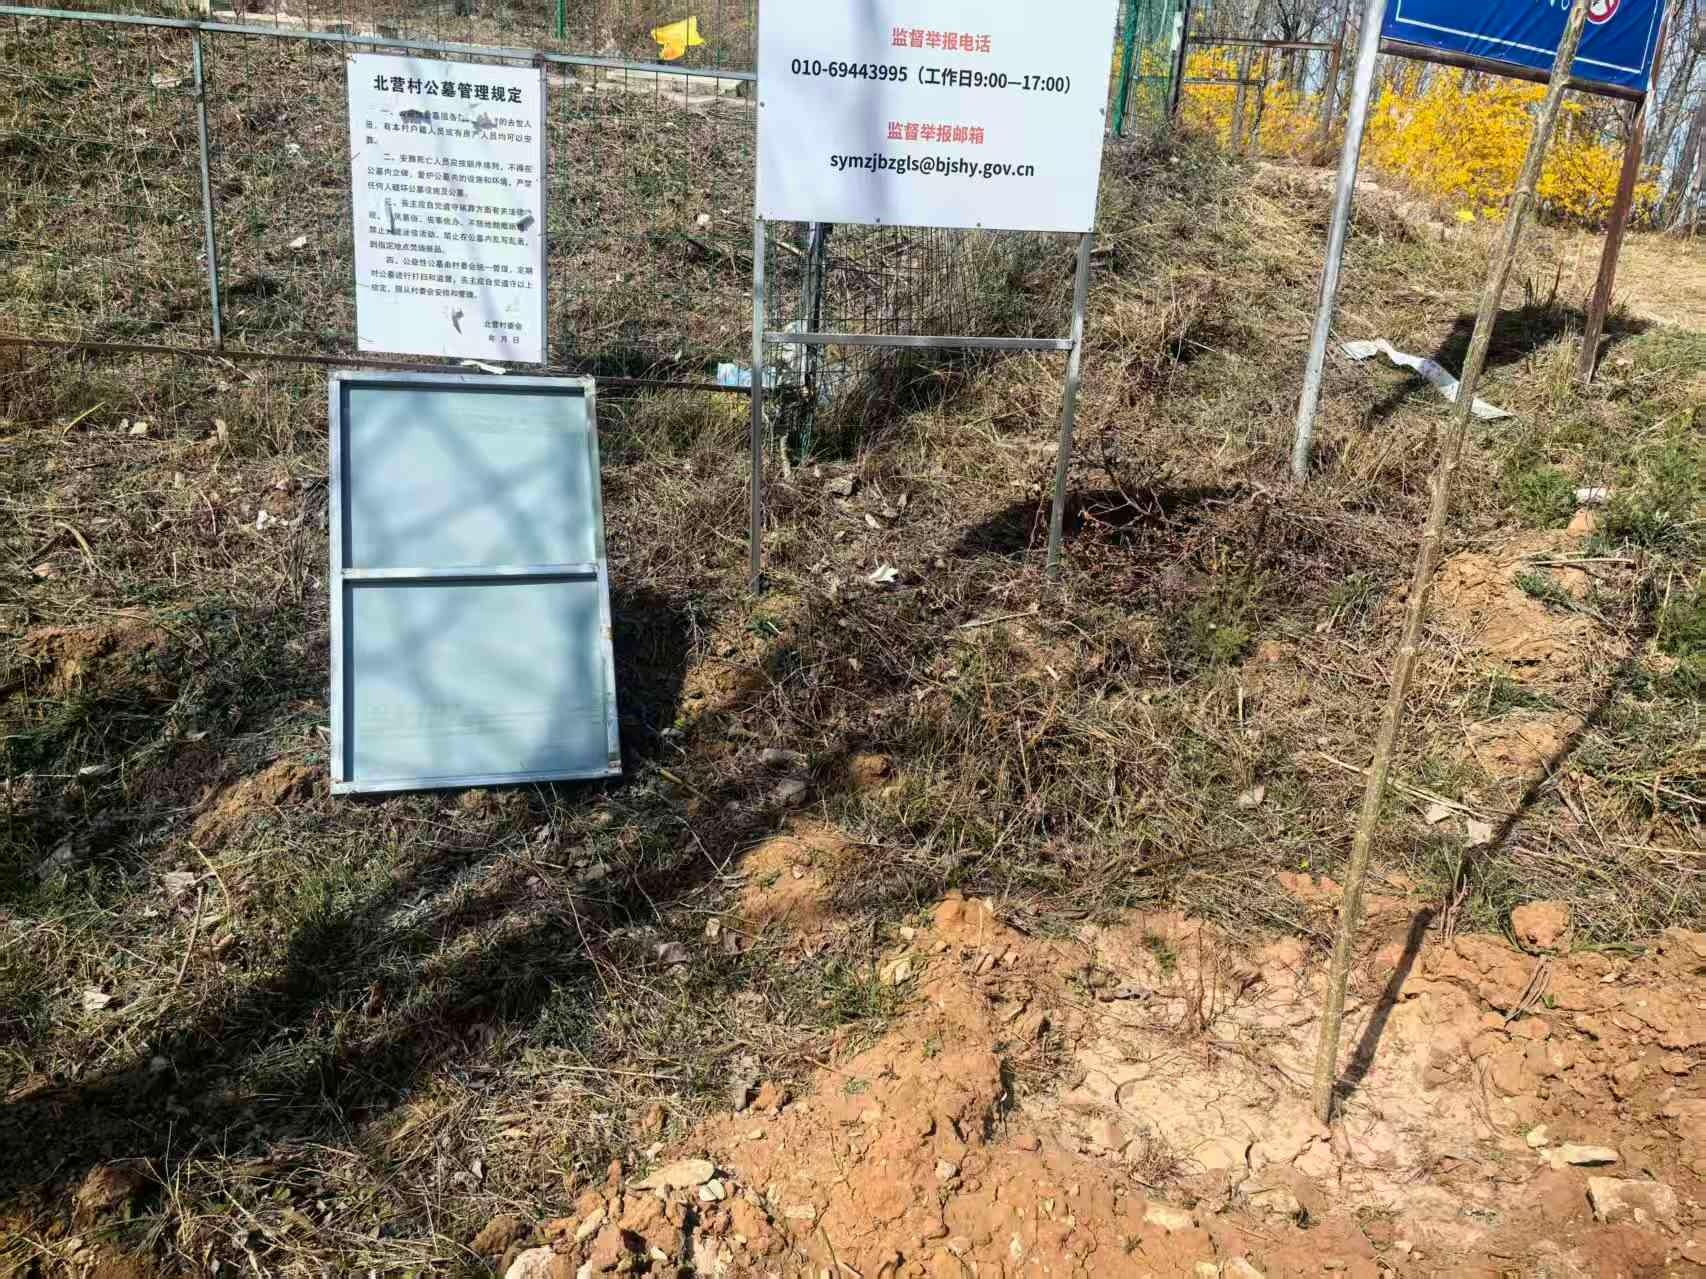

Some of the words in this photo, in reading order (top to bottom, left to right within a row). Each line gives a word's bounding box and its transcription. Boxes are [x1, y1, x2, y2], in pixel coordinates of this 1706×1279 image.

[891, 27, 991, 53] 监督举报电话
[373, 75, 522, 104] 北营村公墓管理规定
[887, 121, 984, 145] 监督举报邮箱
[830, 153, 1034, 179] symzjbzgls@bjshy.gov.cn
[485, 320, 522, 330] 北营村委会
